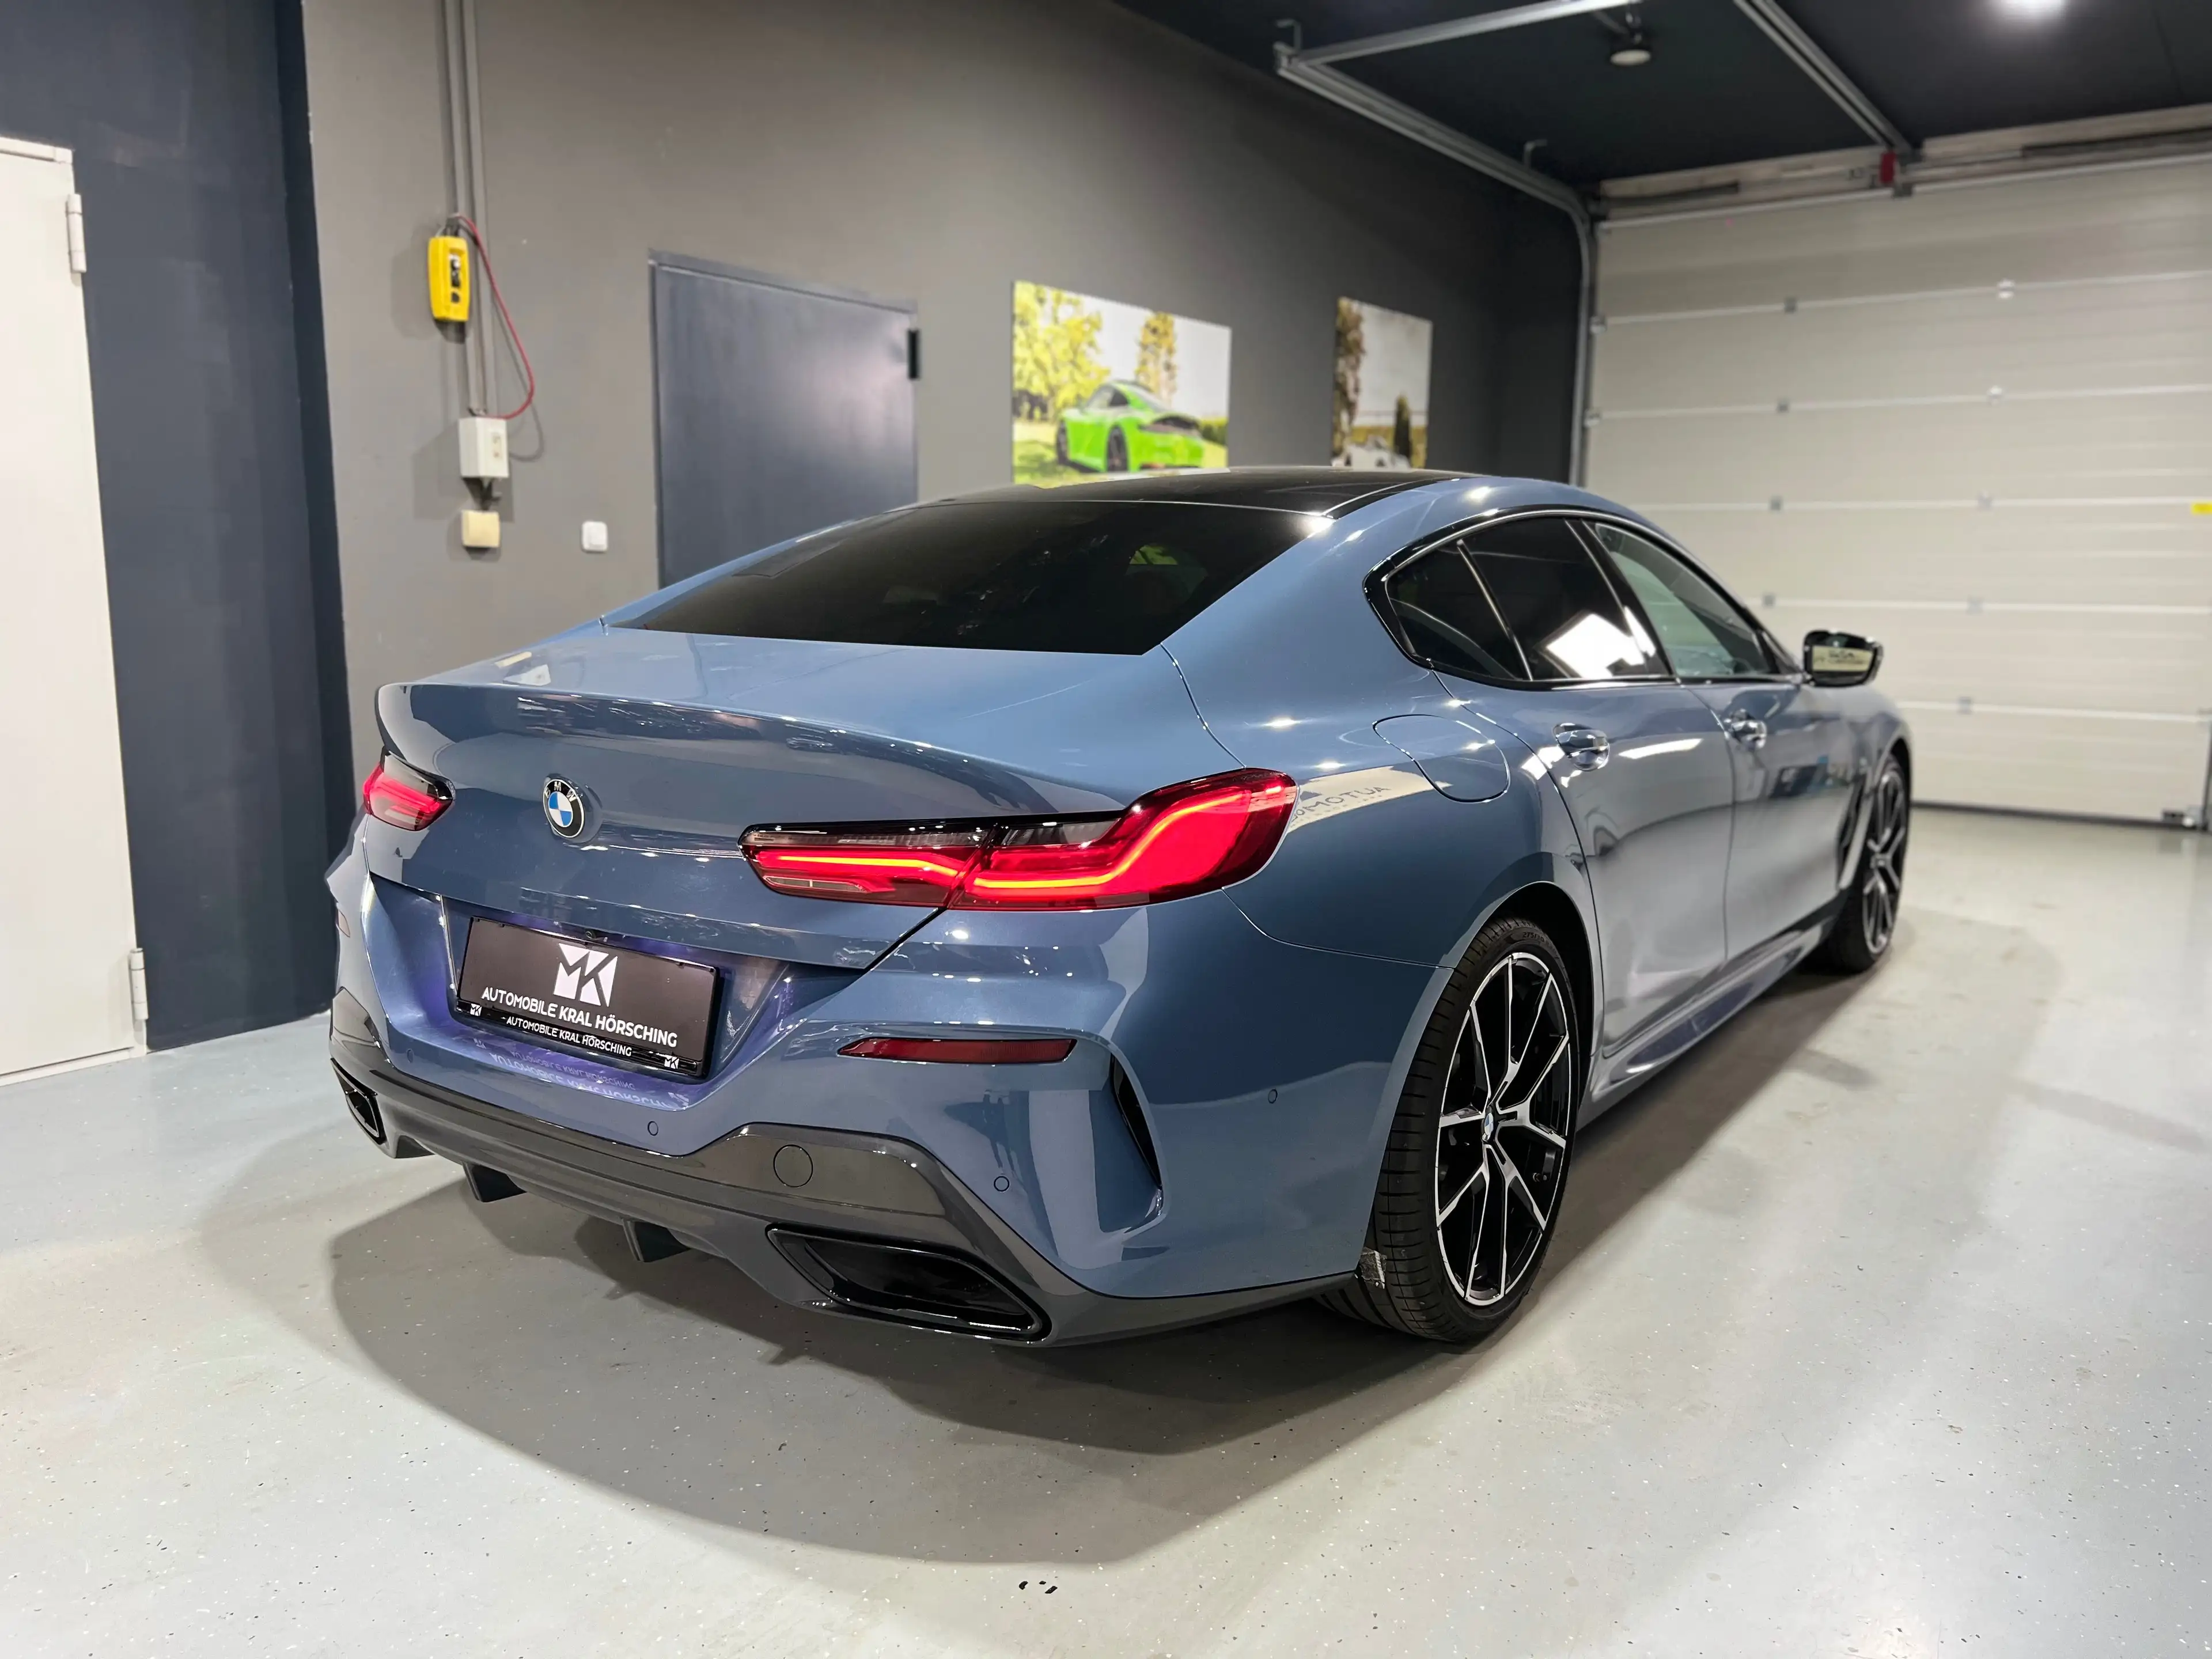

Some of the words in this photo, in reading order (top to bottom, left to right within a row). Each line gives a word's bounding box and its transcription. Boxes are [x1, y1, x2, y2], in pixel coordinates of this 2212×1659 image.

[544, 781, 577, 802] BMW
[482, 987, 558, 1018] AUTOMOBILE
[559, 1006, 592, 1027] KRAL
[594, 1014, 677, 1047] HÖRSCHING
[506, 1017, 559, 1037] AUTOMOBILE
[559, 1030, 581, 1043] KRAL
